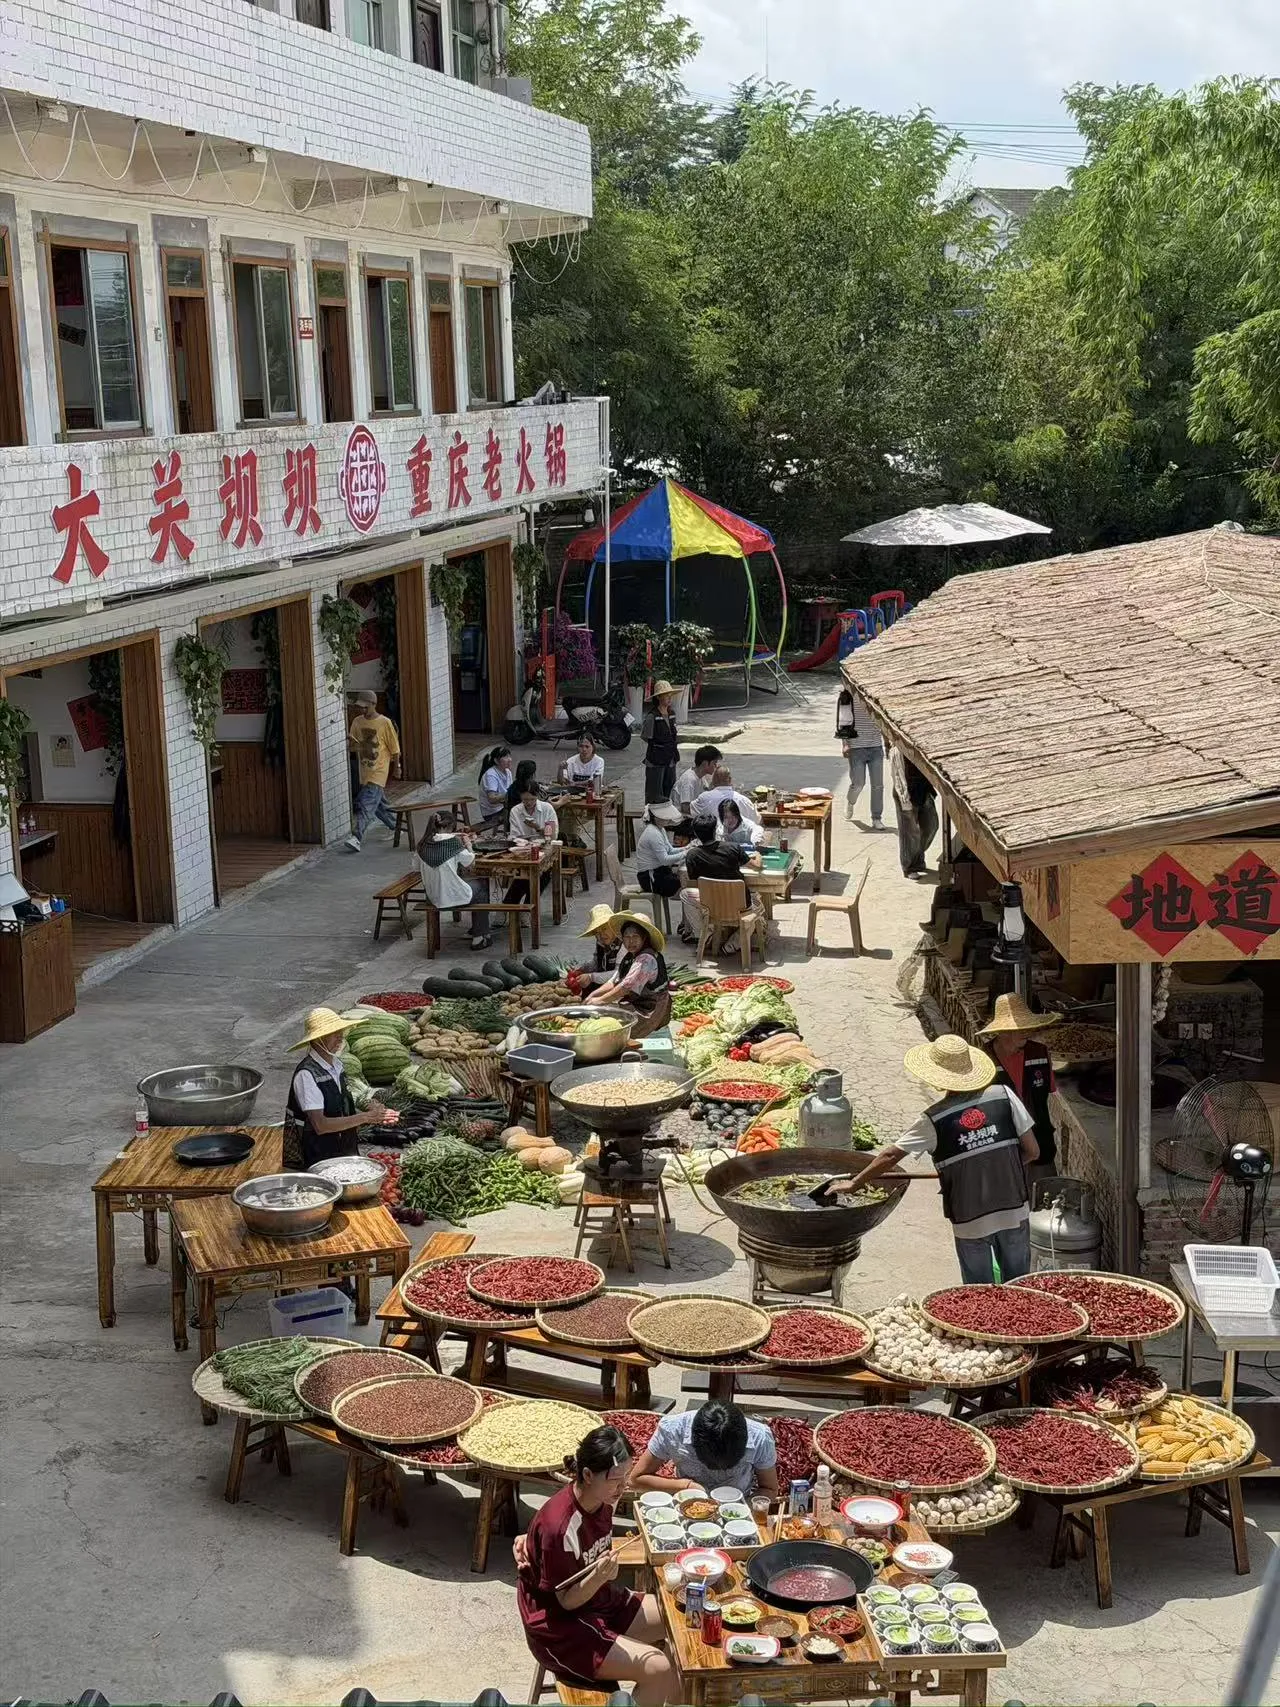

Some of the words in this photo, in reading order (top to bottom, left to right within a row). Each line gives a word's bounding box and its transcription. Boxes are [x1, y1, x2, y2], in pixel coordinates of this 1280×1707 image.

[51, 442, 321, 584] 大关坝坝
[405, 421, 567, 518] 重庆老火锅
